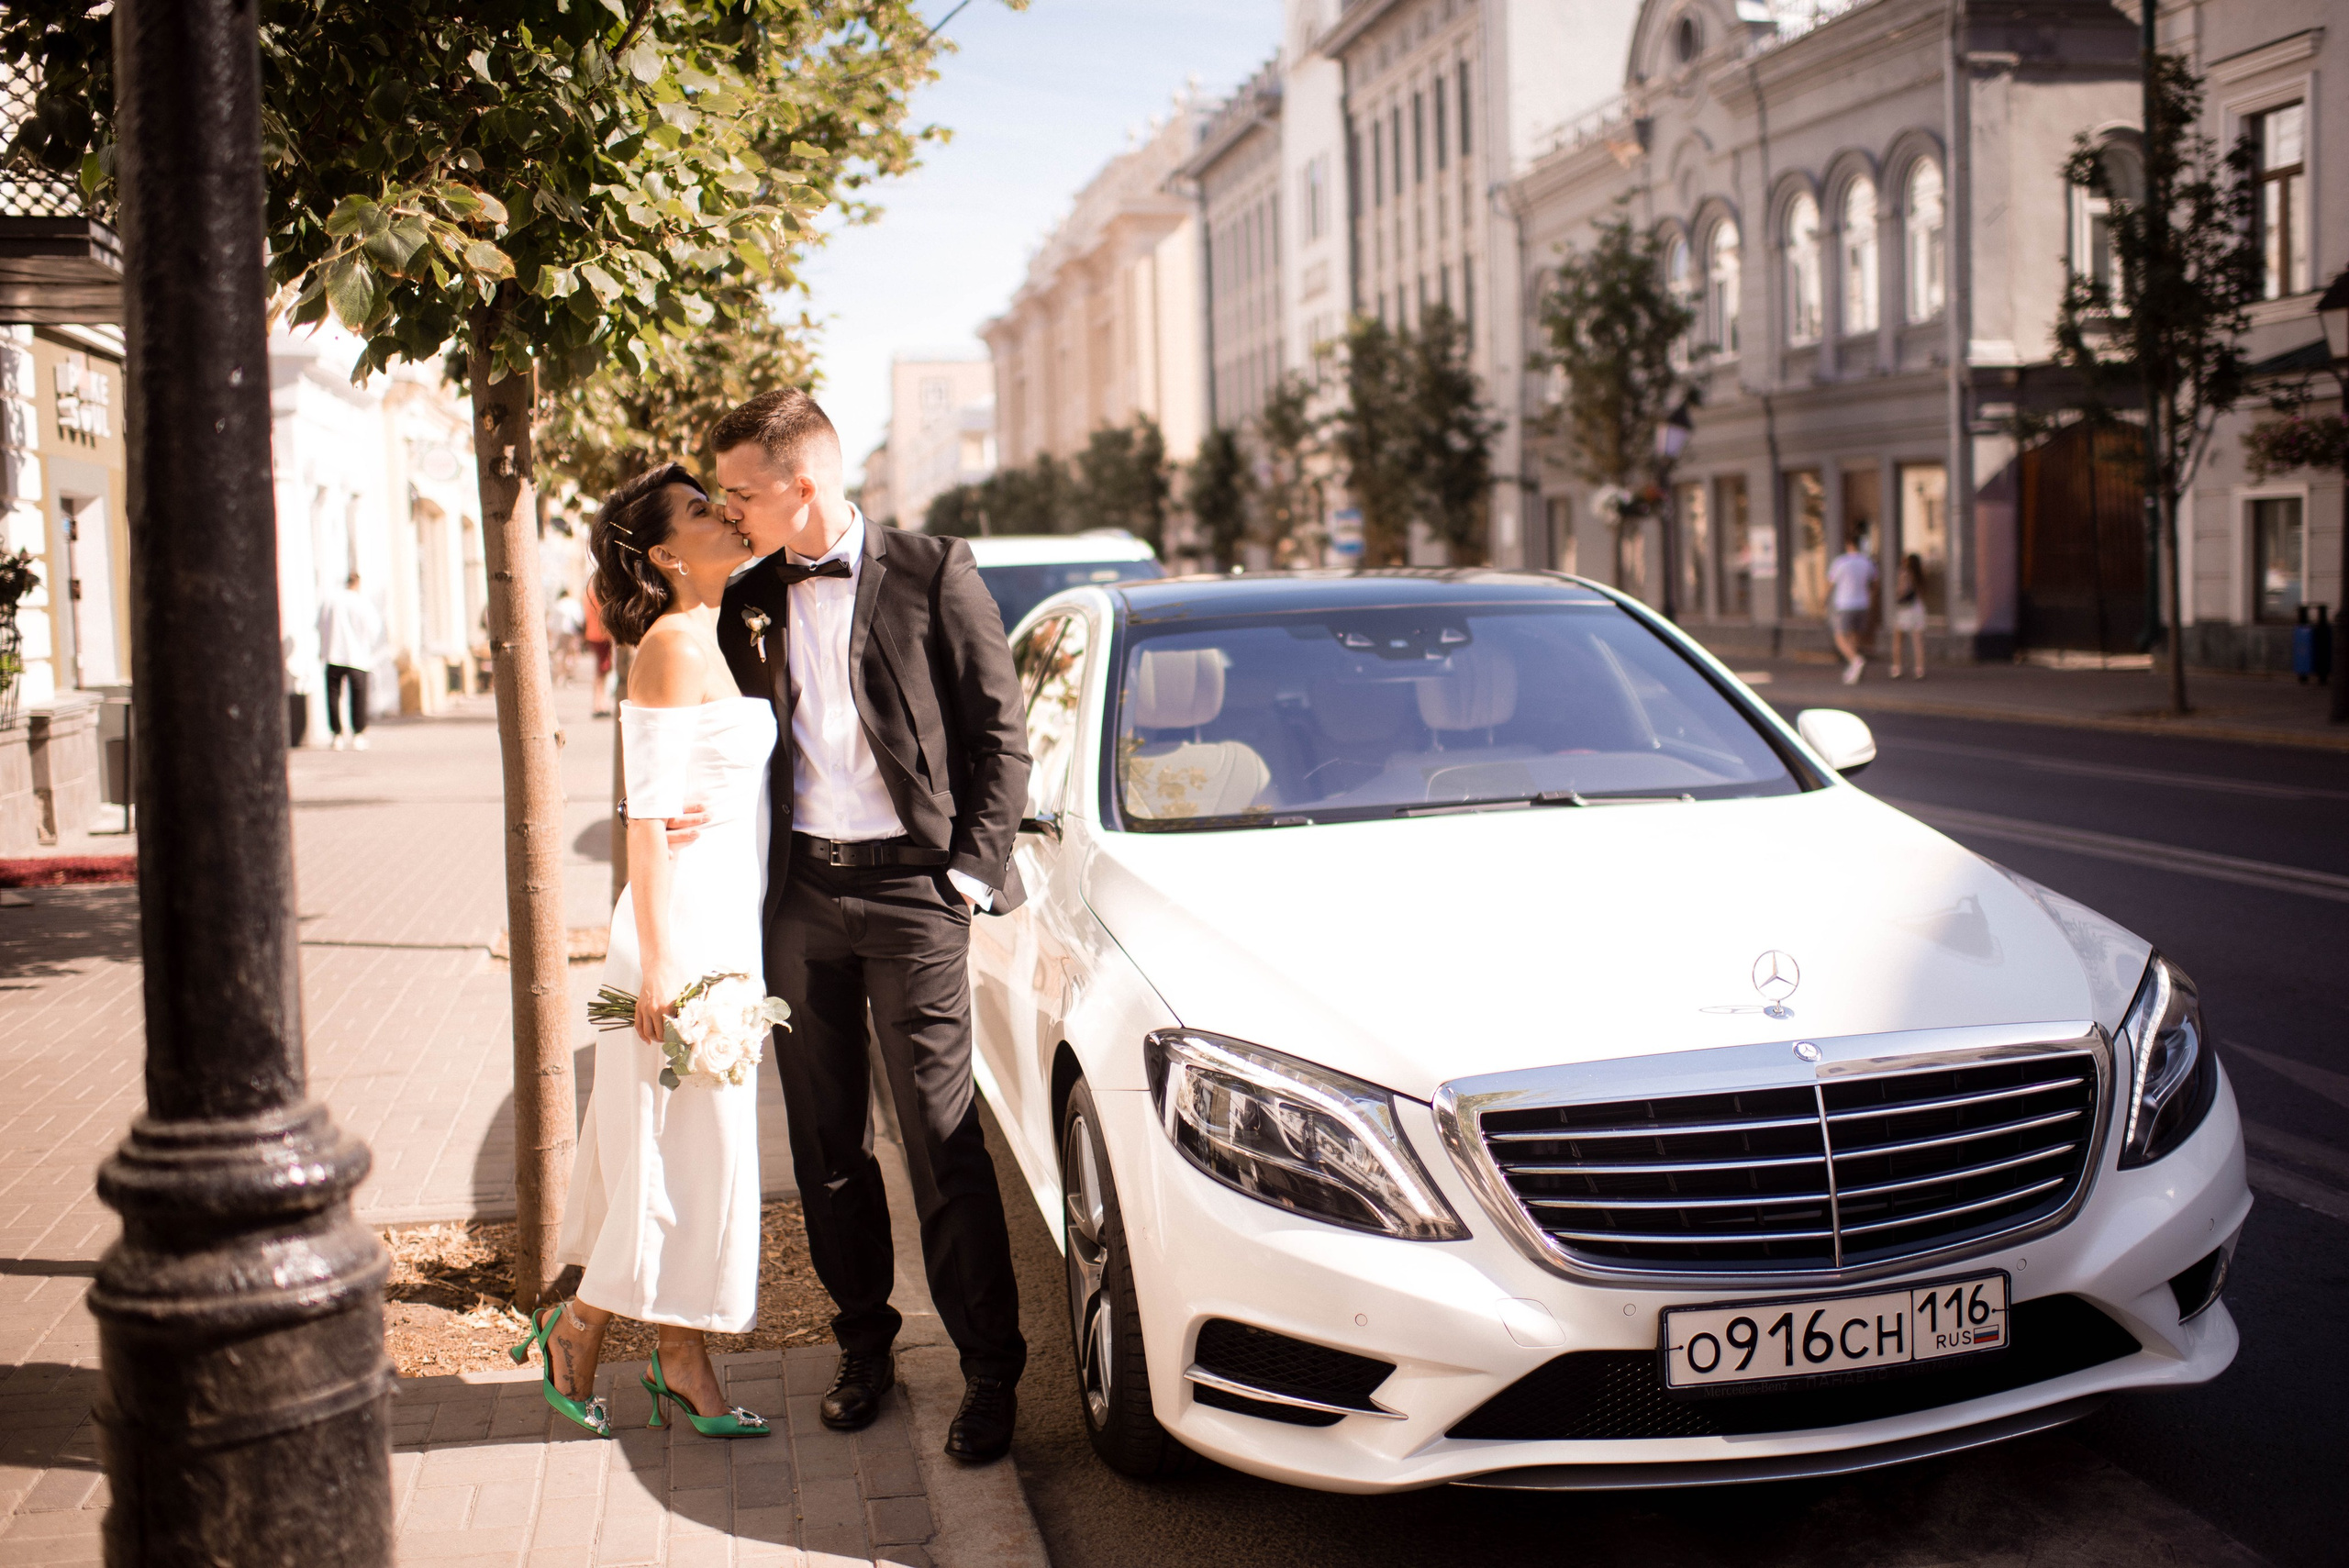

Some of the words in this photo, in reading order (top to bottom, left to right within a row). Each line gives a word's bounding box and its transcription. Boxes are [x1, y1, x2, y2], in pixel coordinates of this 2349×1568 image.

[1917, 1284, 1989, 1333] 116
[1935, 1329, 1972, 1350] RUS
[1703, 1382, 1788, 1398] Mercedes-Benz
[1806, 1368, 1887, 1388] ПАНАВТО
